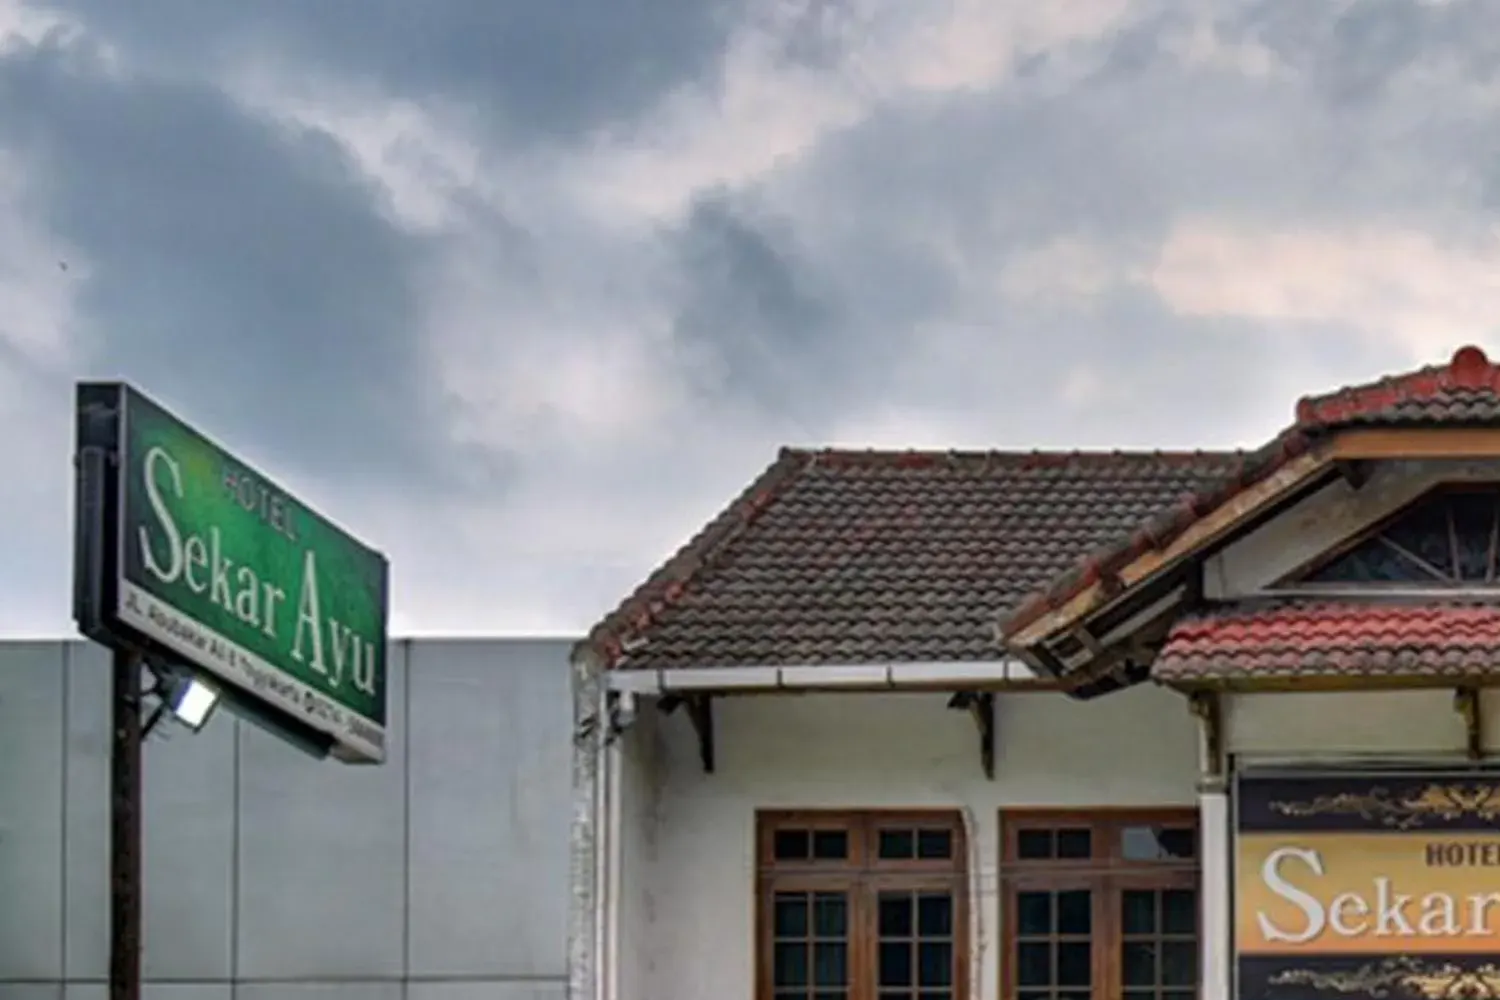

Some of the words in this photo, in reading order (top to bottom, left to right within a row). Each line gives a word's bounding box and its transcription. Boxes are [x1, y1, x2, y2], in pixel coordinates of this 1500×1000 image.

[139, 446, 286, 639] Sekar
[290, 549, 376, 696] Ayu
[224, 465, 297, 543] HOTEL
